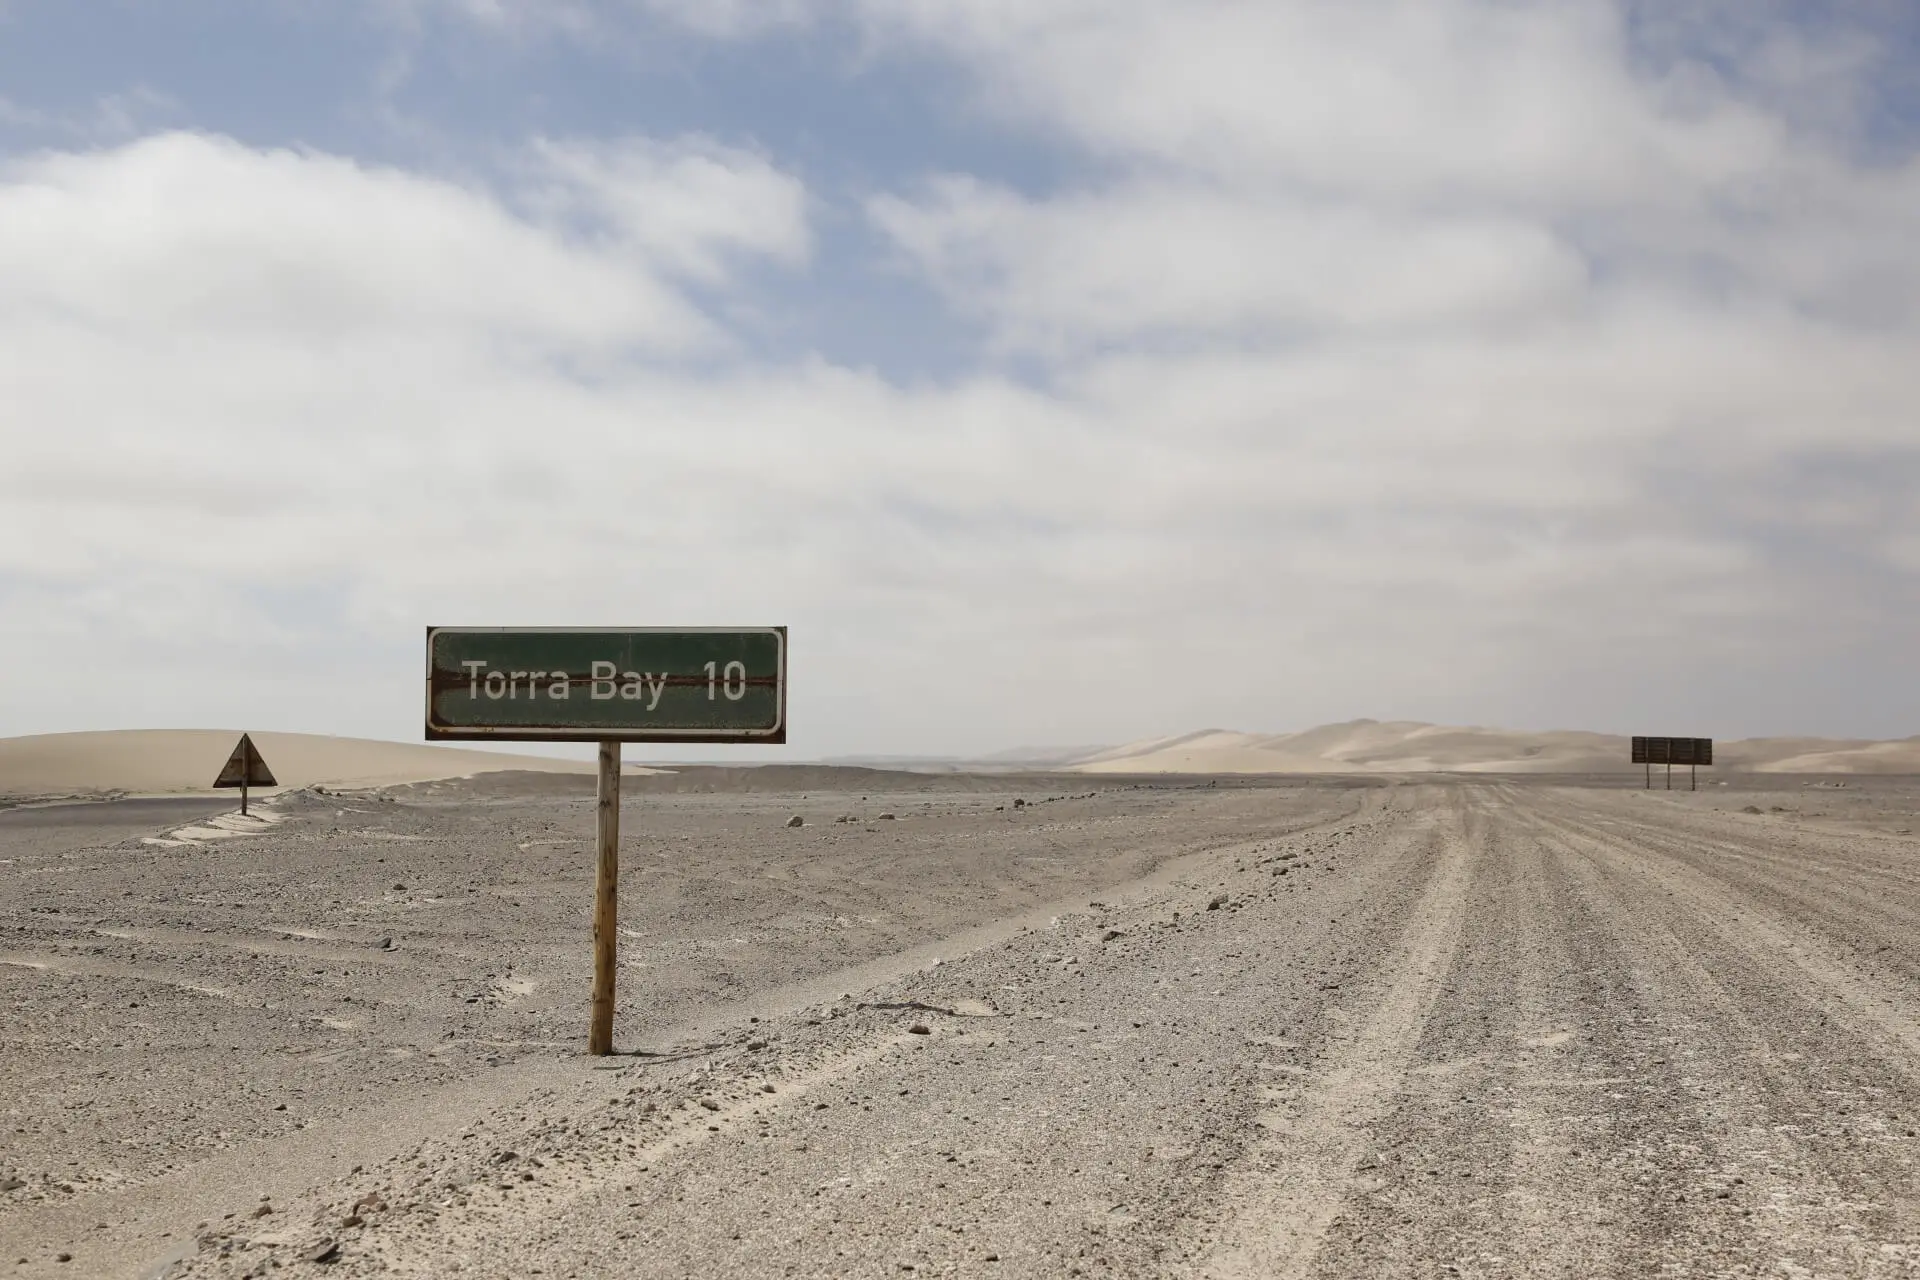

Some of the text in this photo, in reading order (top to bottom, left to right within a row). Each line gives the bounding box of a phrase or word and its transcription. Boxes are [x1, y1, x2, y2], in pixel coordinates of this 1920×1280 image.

[462, 660, 746, 711] Torra Bay 10
